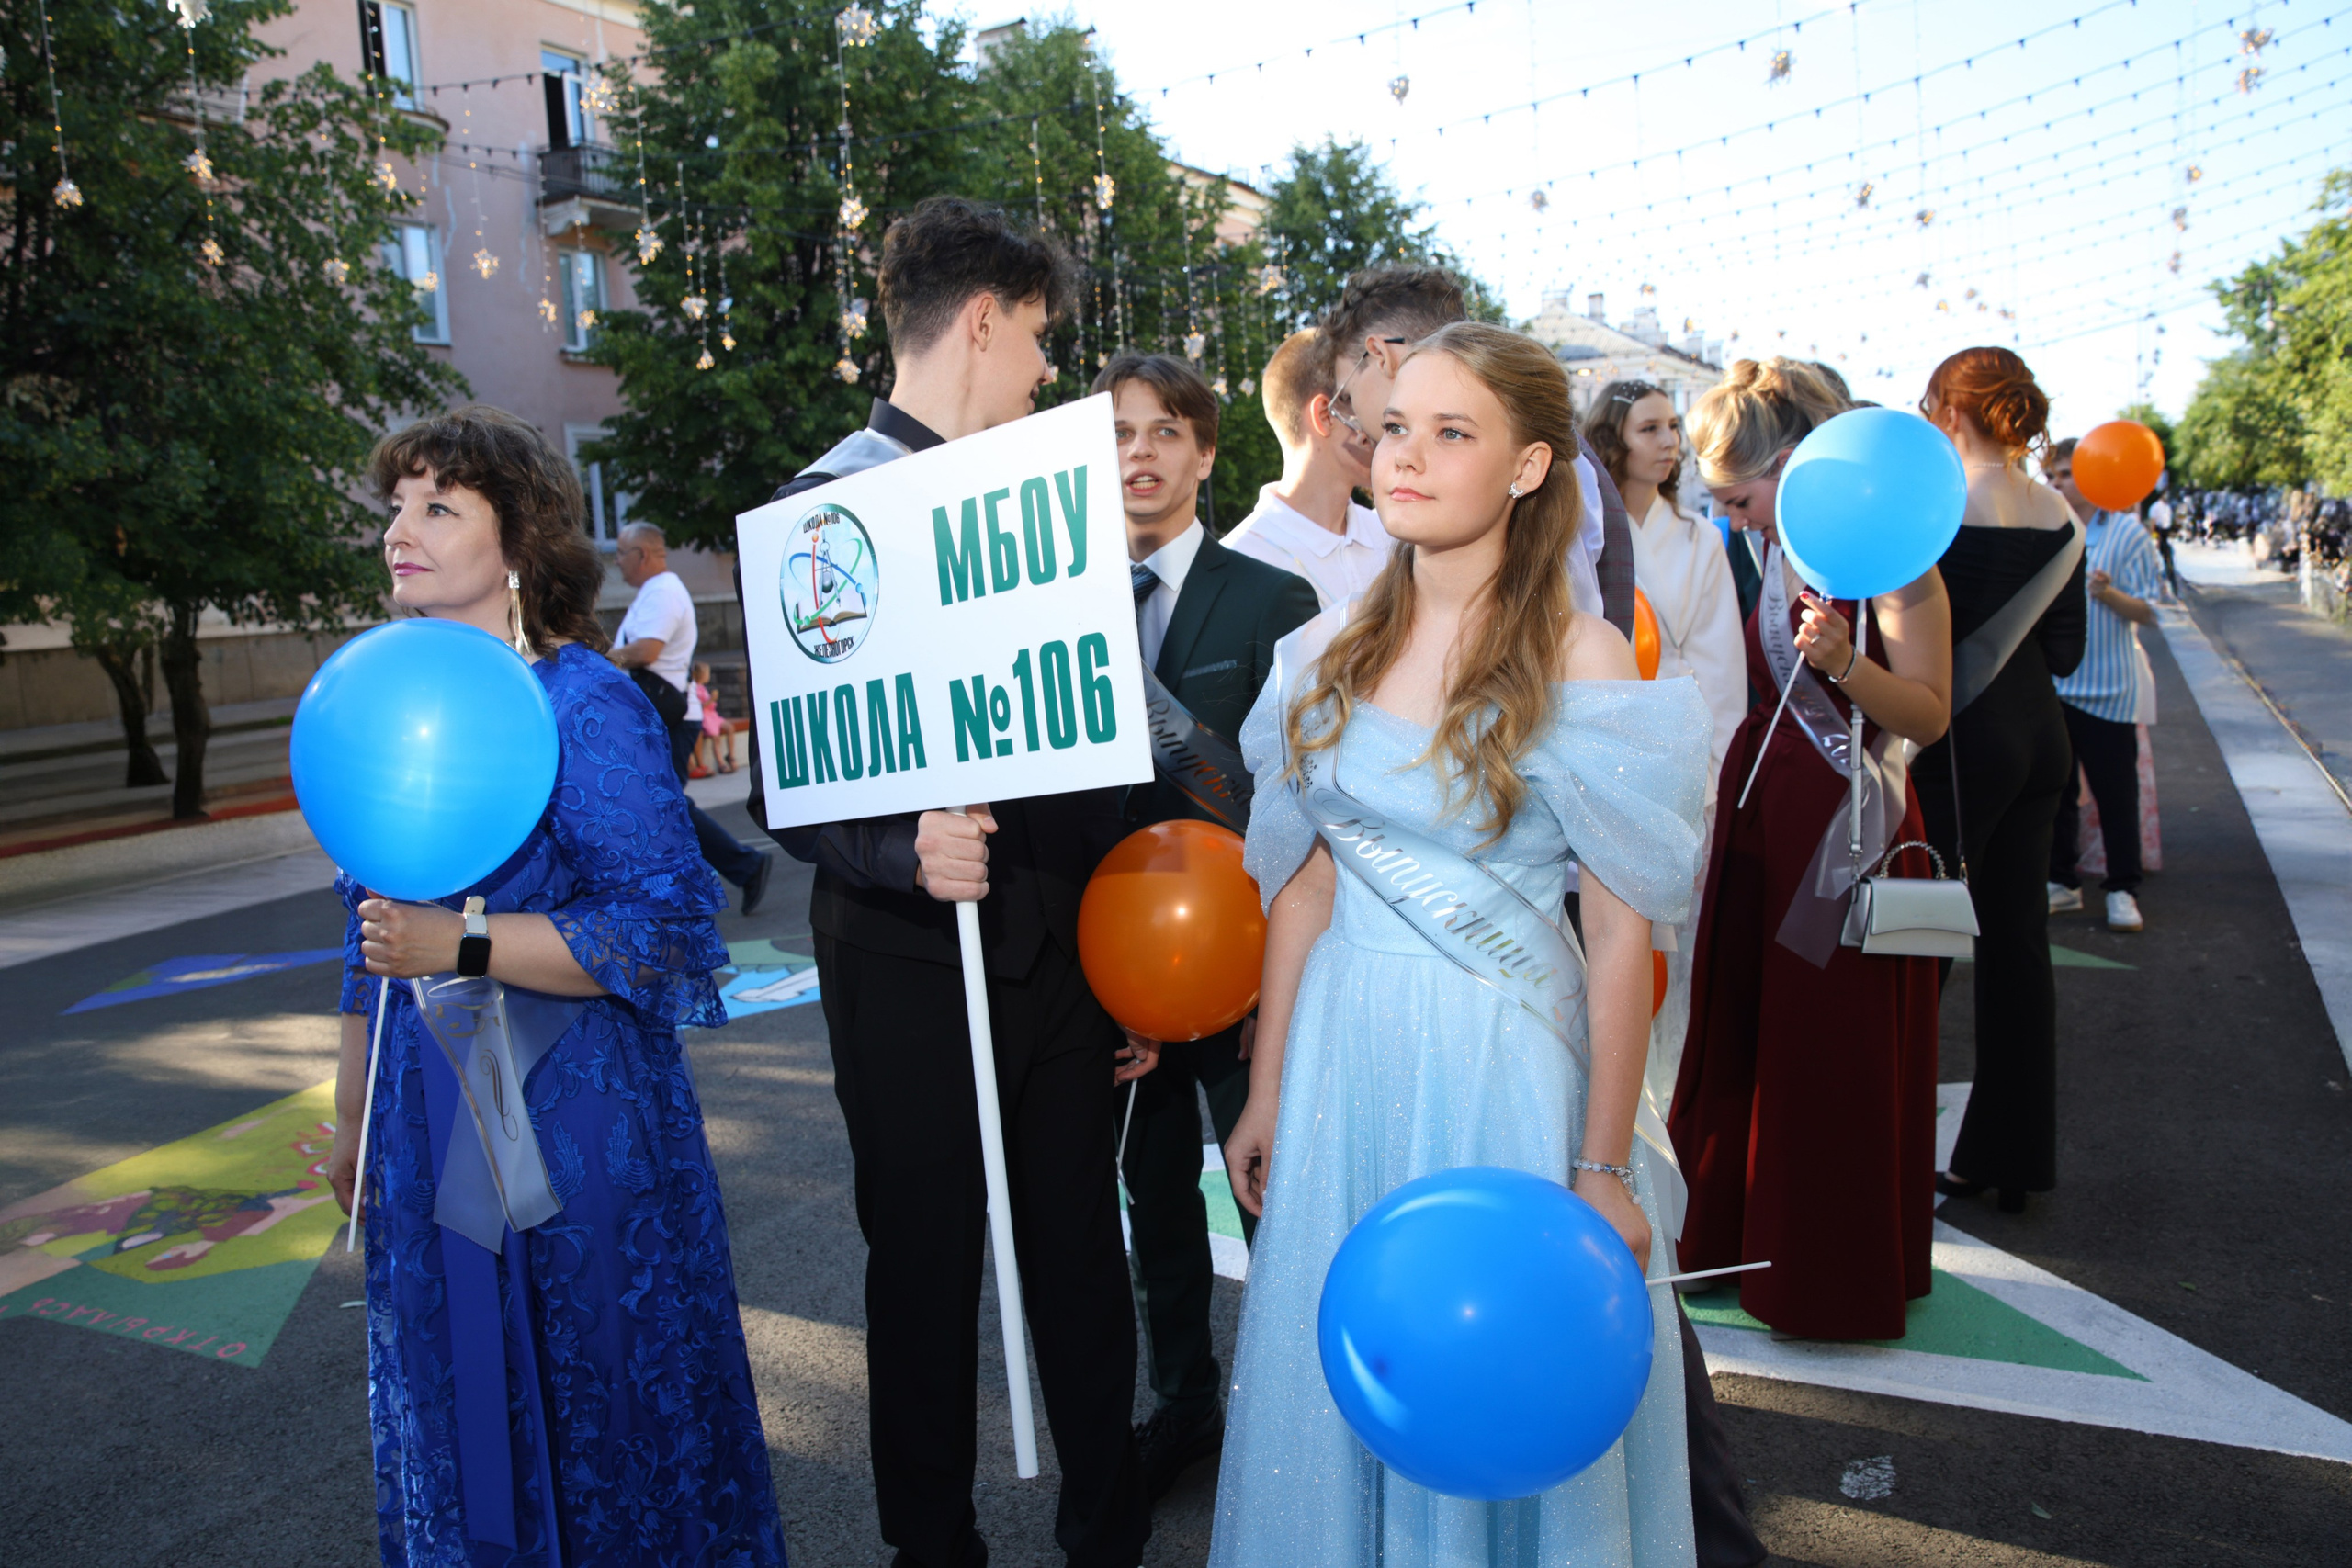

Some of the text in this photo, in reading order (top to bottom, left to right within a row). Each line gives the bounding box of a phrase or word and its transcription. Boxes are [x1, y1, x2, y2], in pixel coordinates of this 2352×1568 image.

[931, 464, 1088, 607] МБОУ
[770, 632, 1118, 790] ШКОЛА №106
[814, 635, 854, 658] ЖЕЛЕЗНОГОРСК
[1311, 788, 1559, 989] Выпускница
